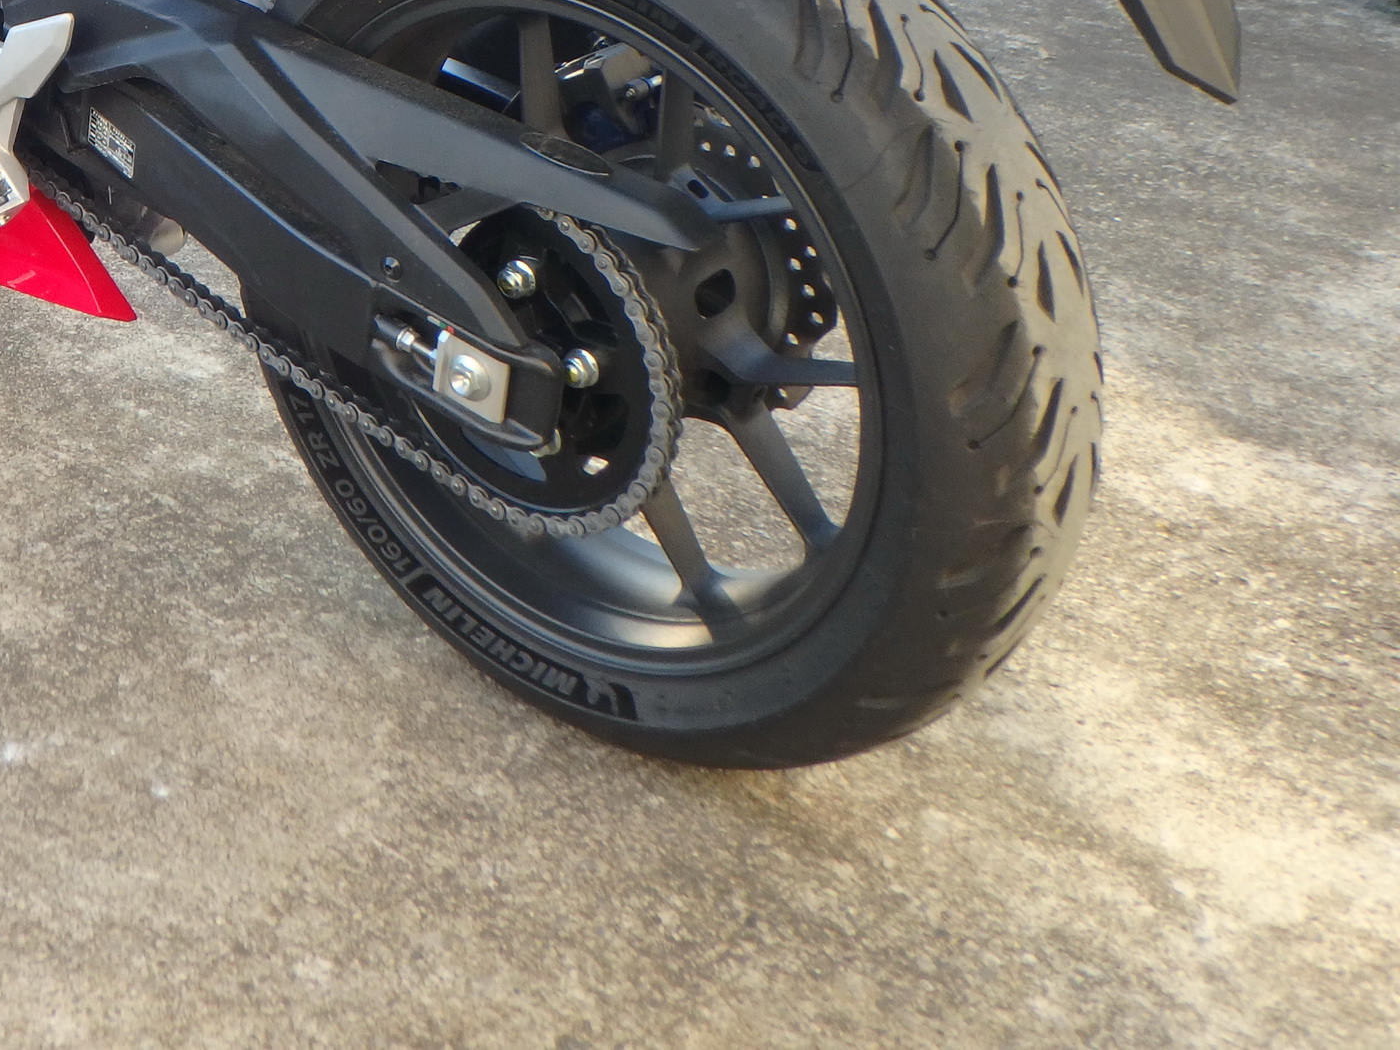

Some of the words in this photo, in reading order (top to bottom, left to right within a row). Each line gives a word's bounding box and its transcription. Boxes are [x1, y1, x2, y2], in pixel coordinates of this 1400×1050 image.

[288, 393, 315, 424] 17
[307, 430, 340, 470] ZR
[335, 478, 412, 572] 160/60
[421, 586, 580, 696] MICHELIN
